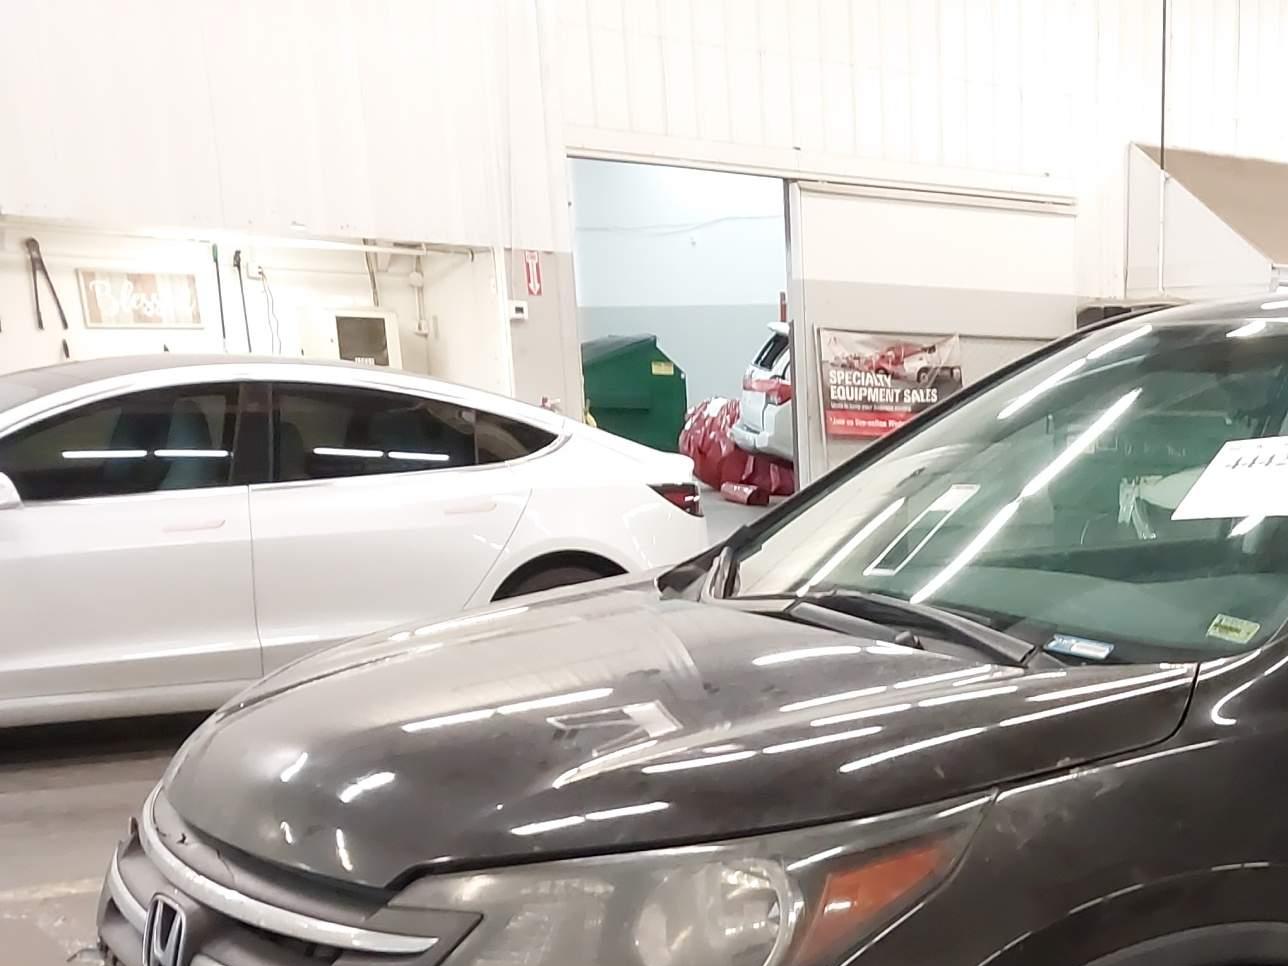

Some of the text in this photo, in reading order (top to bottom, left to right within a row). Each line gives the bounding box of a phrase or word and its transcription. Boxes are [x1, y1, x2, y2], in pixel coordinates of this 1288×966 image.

[829, 369, 892, 388] SPECIALTY
[830, 386, 938, 403] EQUIPMENT SALES
